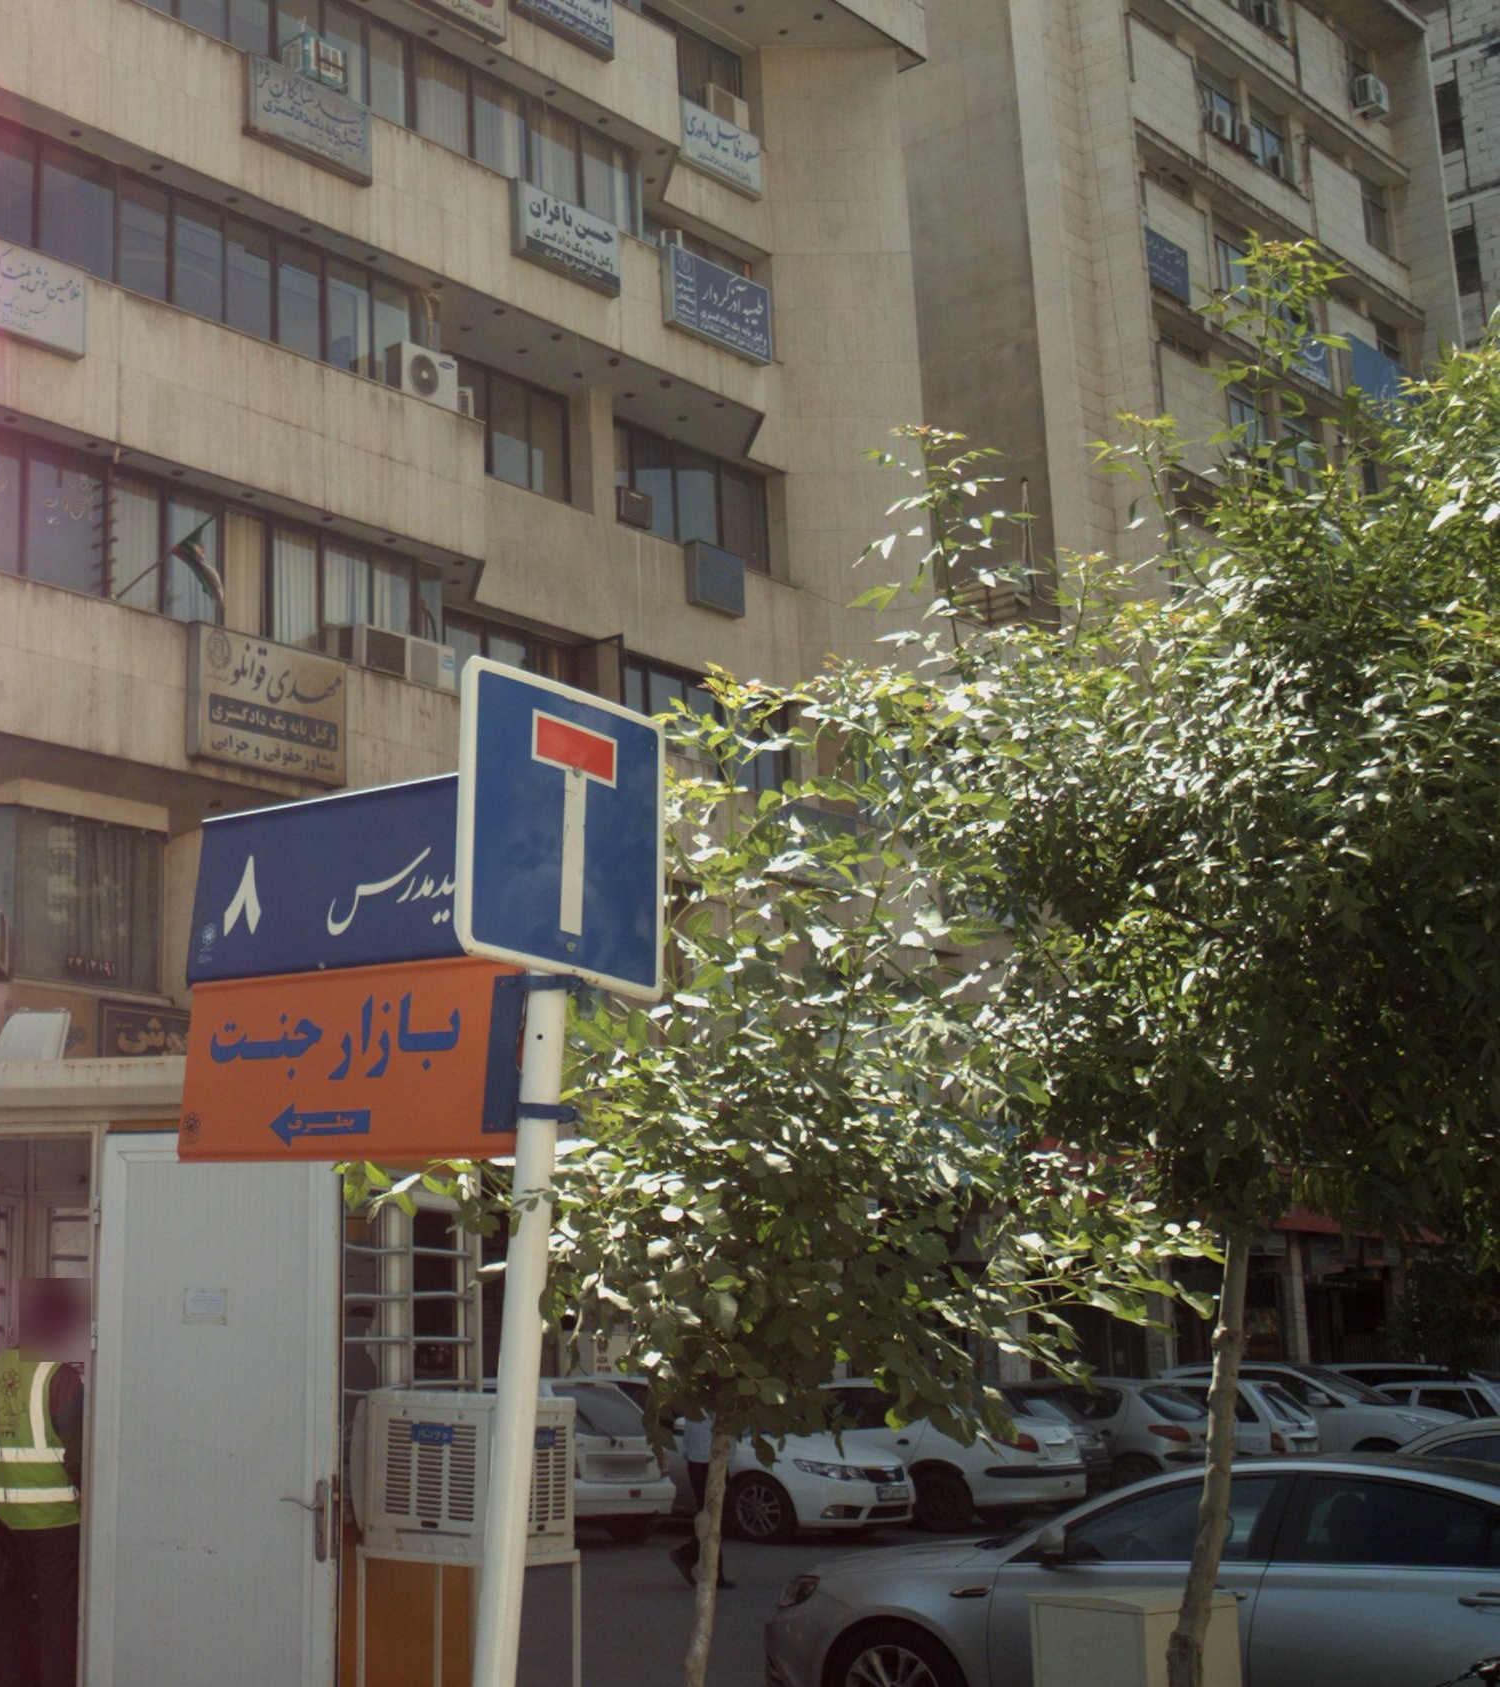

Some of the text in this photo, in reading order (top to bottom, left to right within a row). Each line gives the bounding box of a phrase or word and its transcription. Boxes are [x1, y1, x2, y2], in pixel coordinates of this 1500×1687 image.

[575, 222, 614, 246] حسین
[266, 668, 342, 704] مهدی
[211, 703, 336, 748] وکیل پایه یک دادگستری
[211, 733, 336, 772] مشاور حقوقی و جزایی
[223, 854, 262, 937] ۸
[327, 846, 432, 936] مدرس
[210, 989, 461, 1081] بازار جنت
[286, 1113, 356, 1133] بطرف
